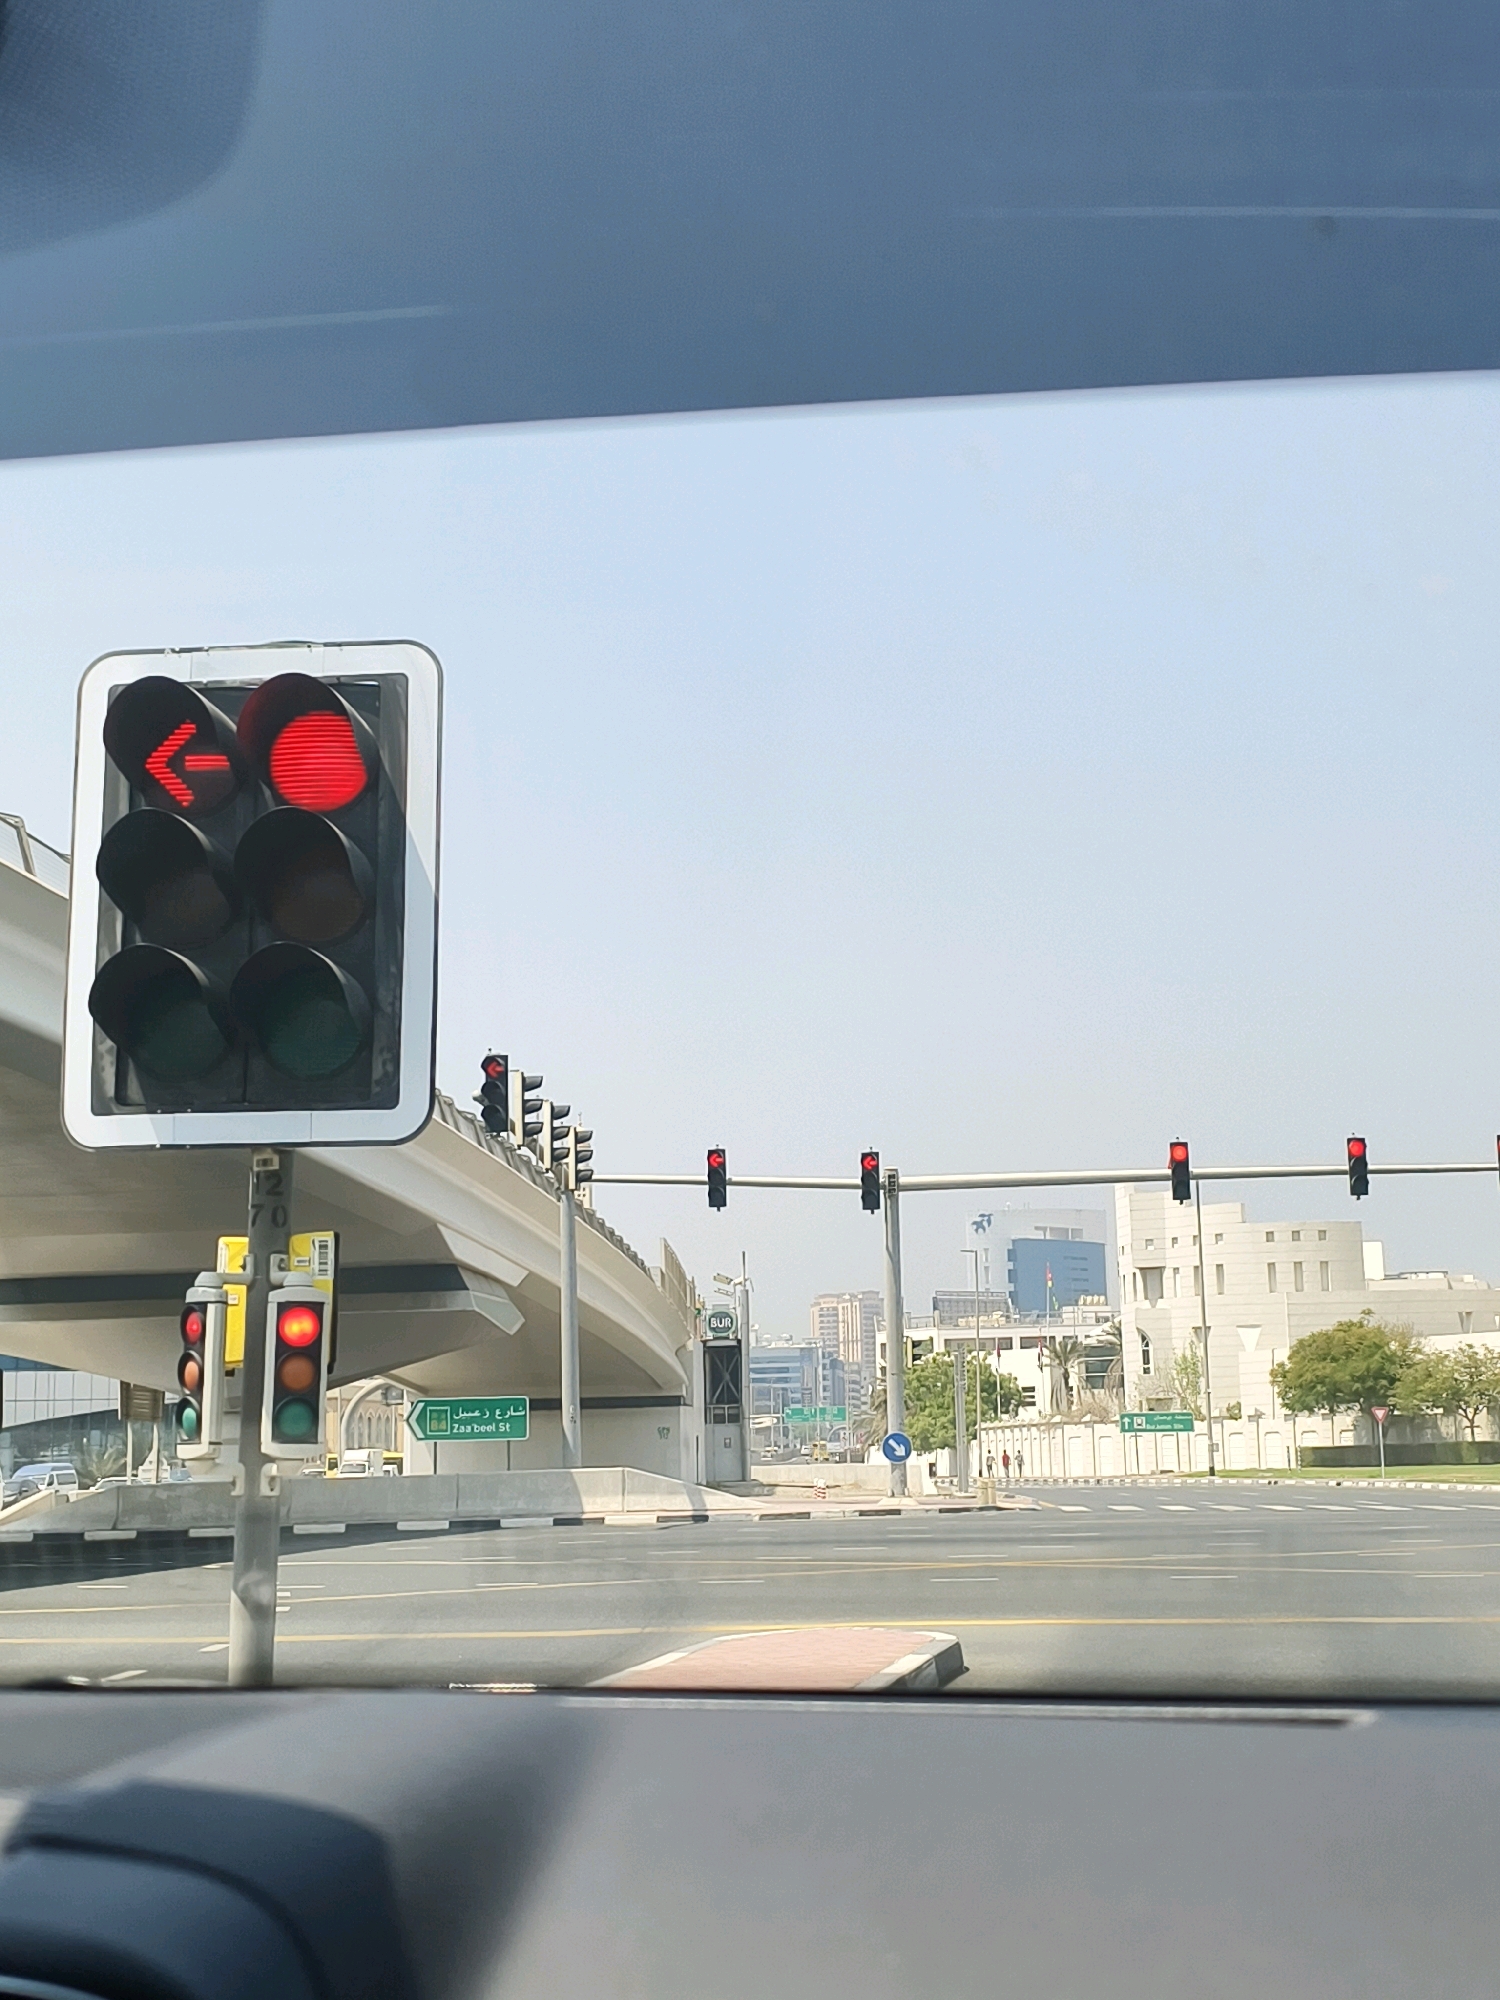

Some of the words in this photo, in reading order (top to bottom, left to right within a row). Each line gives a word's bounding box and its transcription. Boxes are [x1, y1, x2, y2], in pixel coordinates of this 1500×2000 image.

[251, 1204, 287, 1228] 70
[710, 1317, 732, 1328] BUR
[495, 1405, 526, 1420] شارع
[498, 1422, 511, 1433] St
